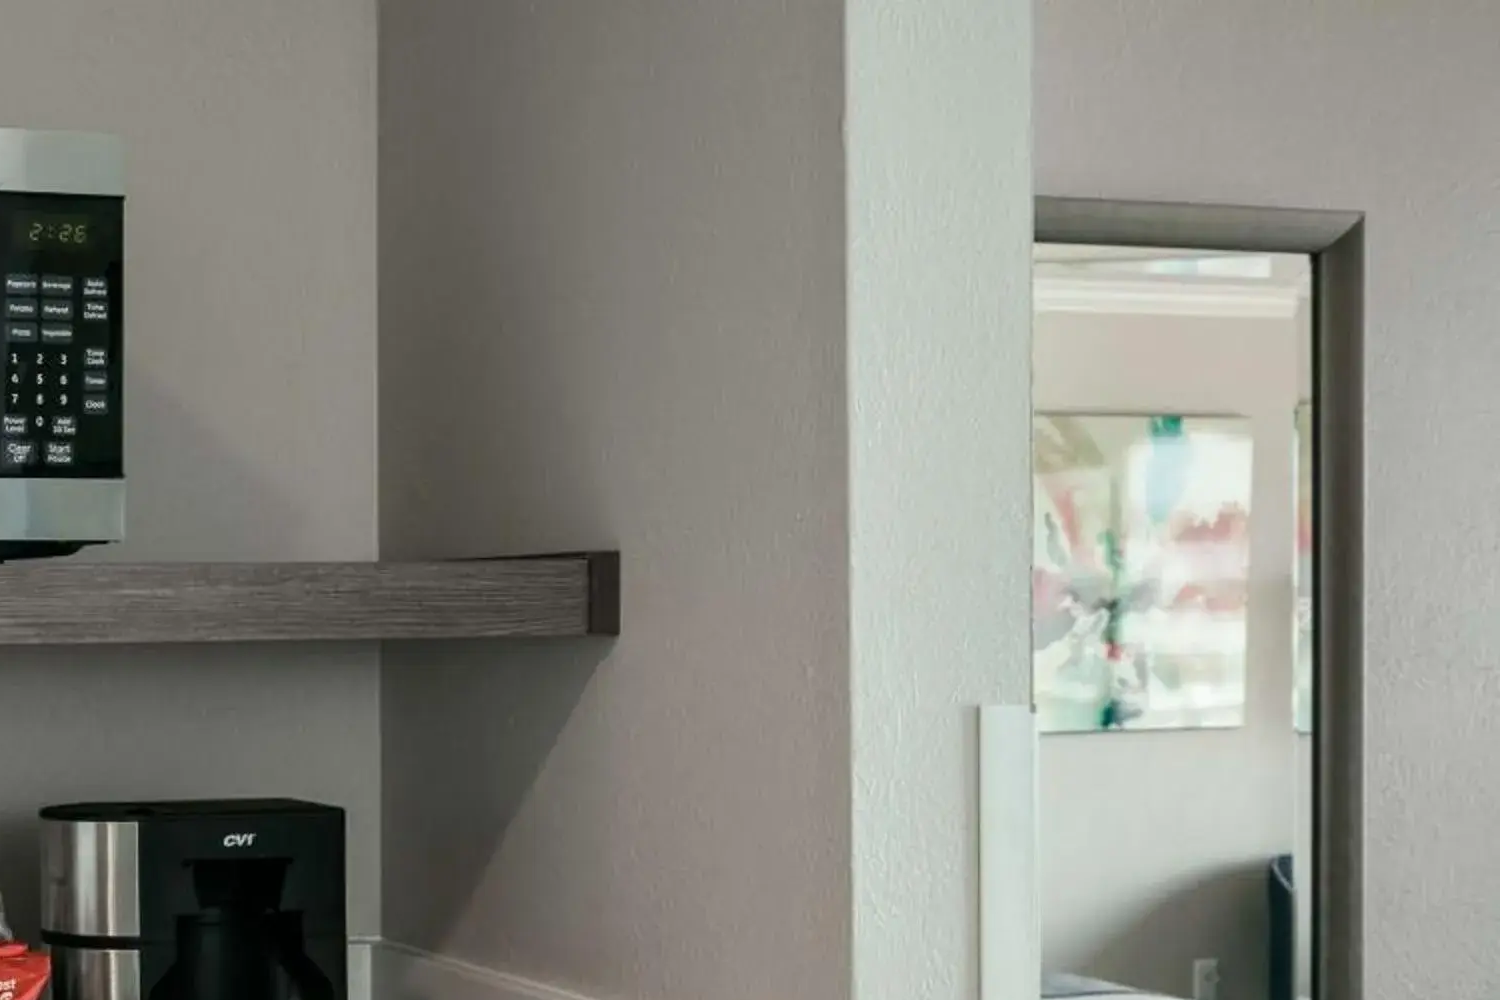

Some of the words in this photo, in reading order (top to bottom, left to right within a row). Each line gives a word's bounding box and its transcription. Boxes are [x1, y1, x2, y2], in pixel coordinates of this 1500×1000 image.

[29, 222, 87, 243] 2:26
[11, 353, 19, 363] 1
[36, 353, 43, 365] 2
[61, 354, 67, 365] 3
[11, 373, 19, 383] 4
[36, 373, 43, 385] 5
[60, 375, 67, 385] 6
[11, 393, 19, 404] 7
[36, 394, 43, 405] 8
[60, 394, 67, 405] 9
[35, 416, 44, 427] 0
